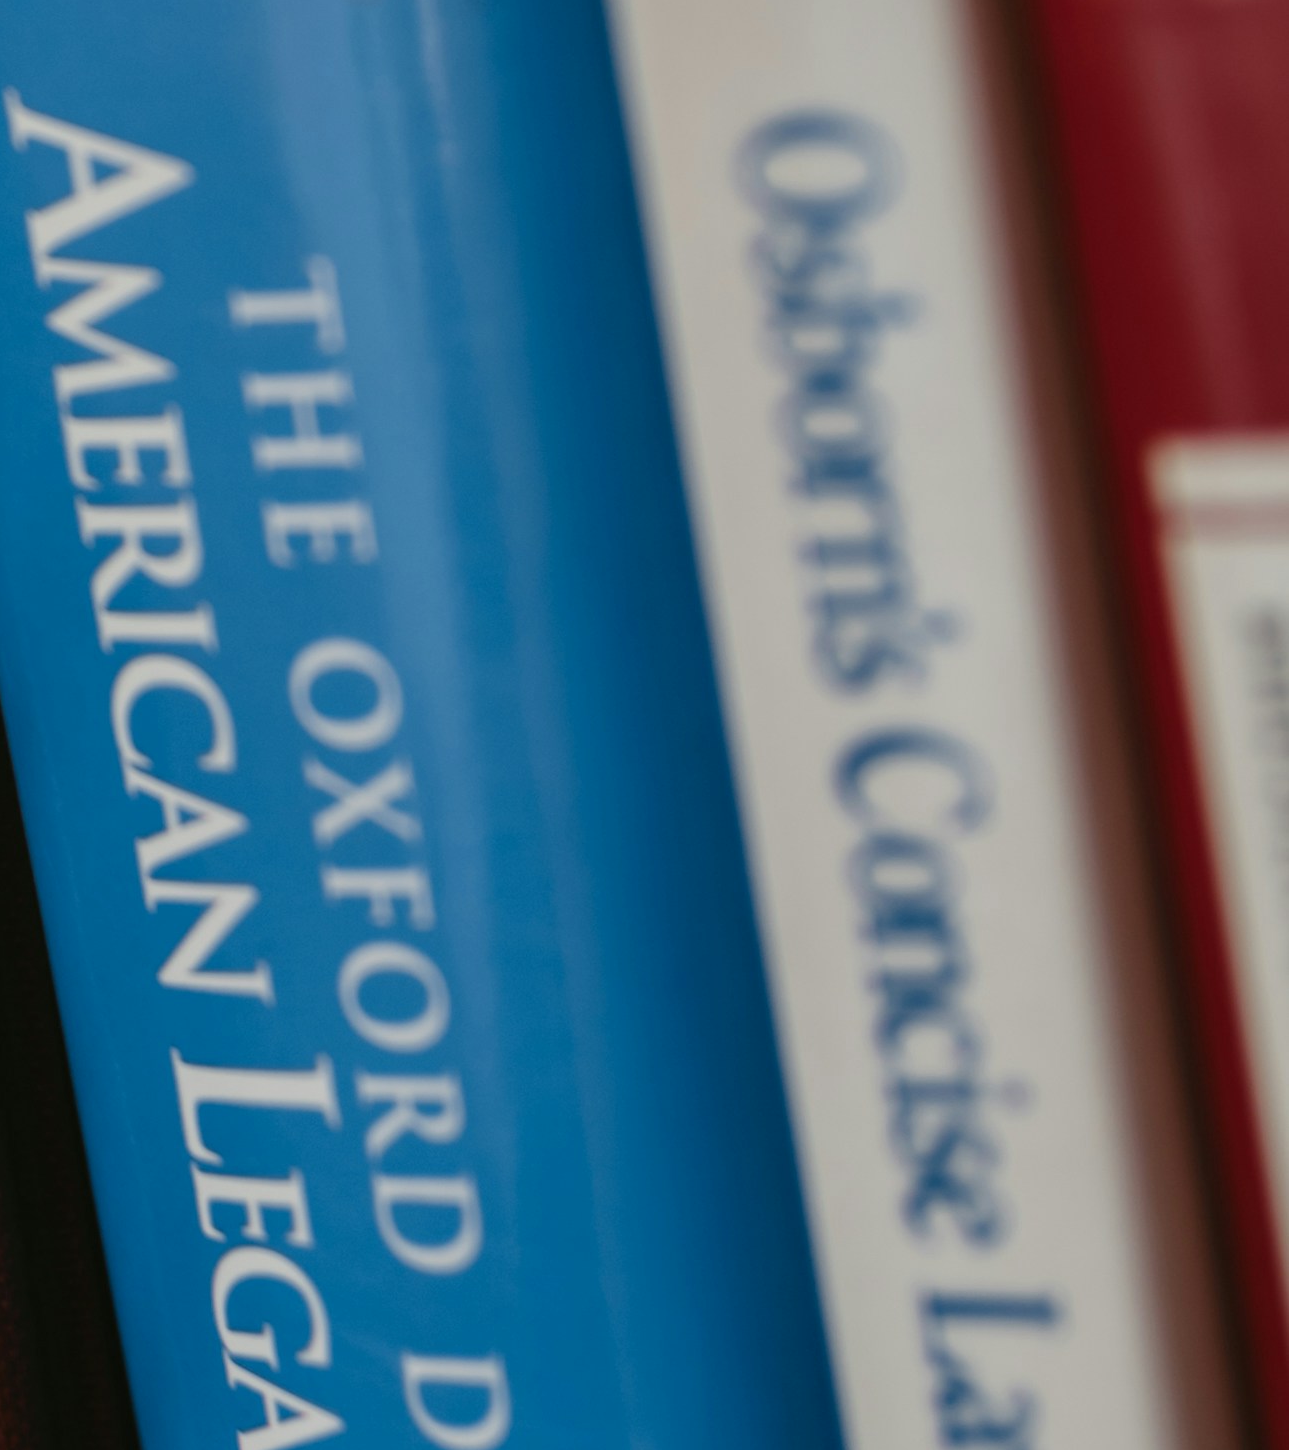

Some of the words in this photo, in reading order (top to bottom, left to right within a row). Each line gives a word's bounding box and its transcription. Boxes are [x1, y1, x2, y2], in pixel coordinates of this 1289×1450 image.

[3, 89, 275, 1010] AMERICAN
[226, 253, 379, 571] THE
[287, 635, 485, 1277] OXFORD
[832, 722, 1035, 1257] Concise
